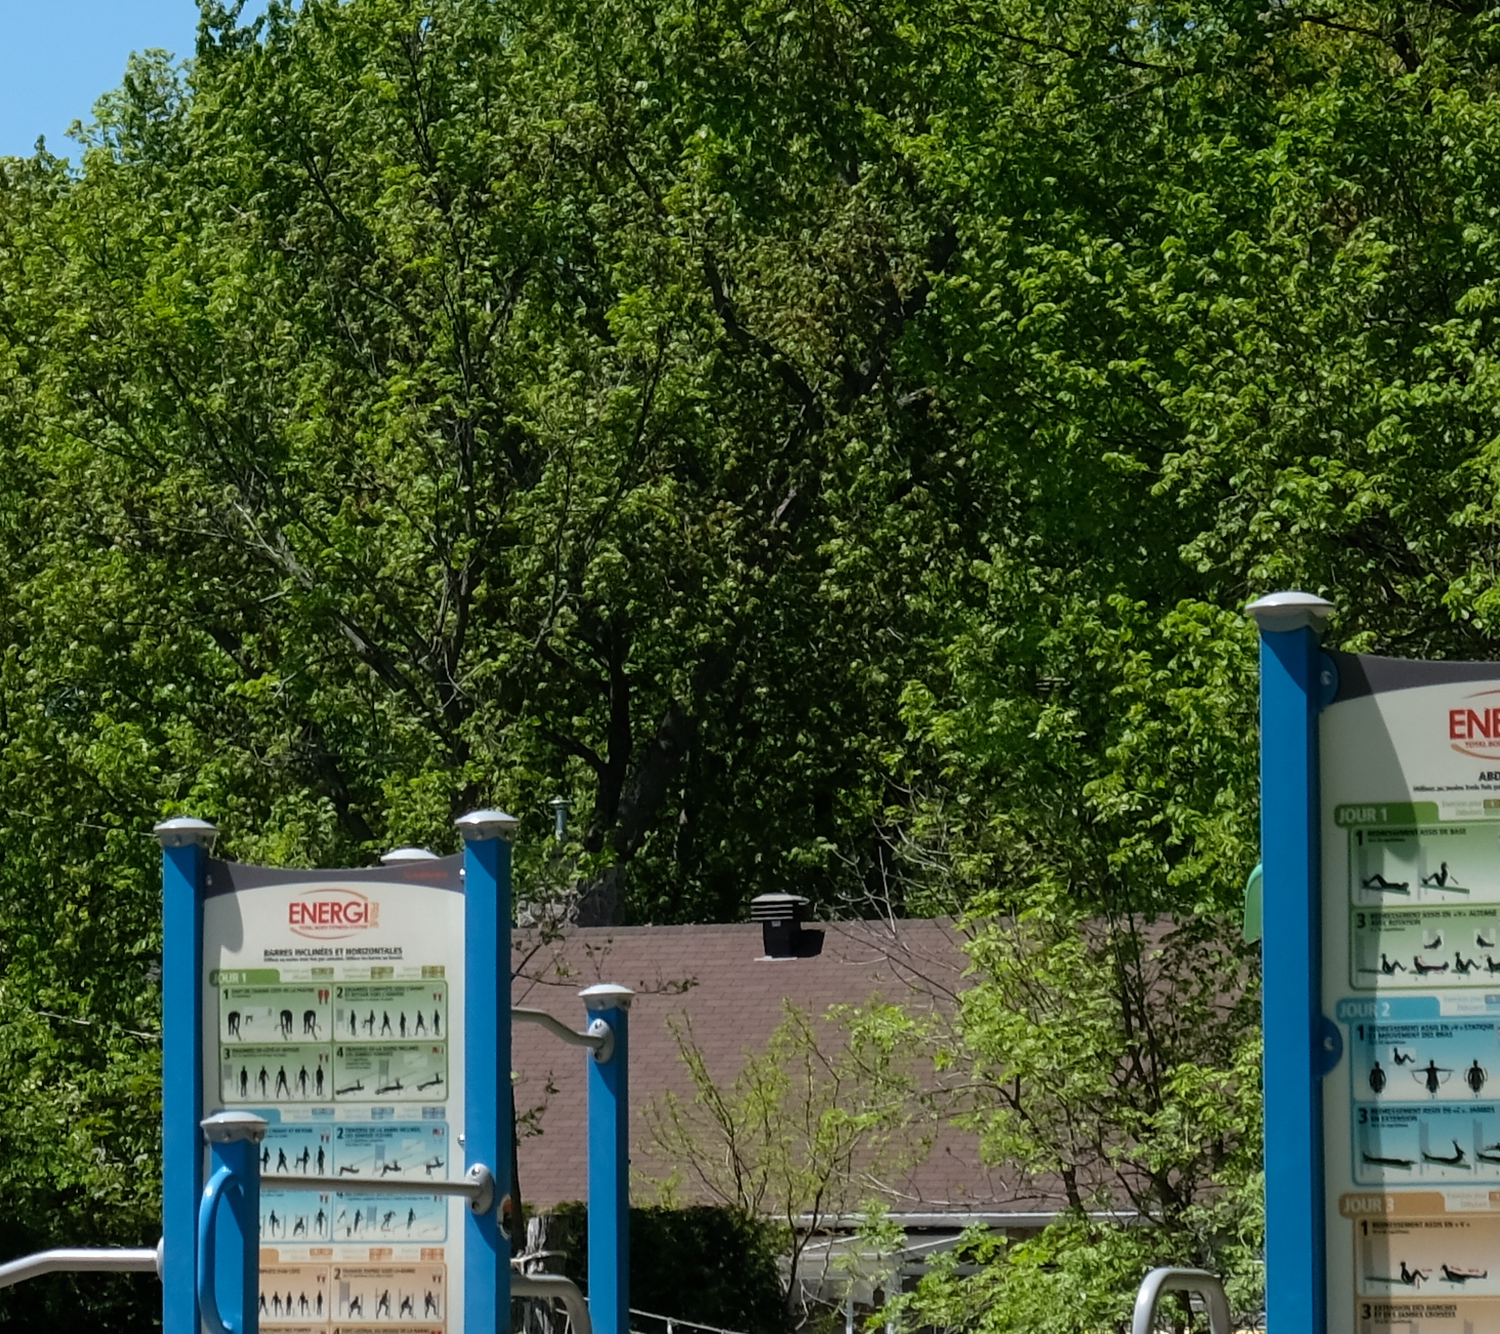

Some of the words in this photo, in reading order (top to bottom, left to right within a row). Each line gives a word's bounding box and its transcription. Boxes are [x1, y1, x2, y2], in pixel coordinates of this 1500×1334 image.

[1339, 808, 1377, 823] JOUR
[1381, 808, 1387, 821] 1
[1356, 830, 1363, 846] 1
[289, 902, 368, 924] ENERGI
[1357, 913, 1366, 929] 3
[264, 949, 292, 957] BARRES
[345, 947, 402, 955] HORIZONTALES
[242, 973, 246, 983] 1
[224, 990, 229, 999] 1
[337, 989, 343, 999] 2
[1340, 1003, 1377, 1017] JOUR
[1382, 1002, 1390, 1016] 2
[1357, 1025, 1364, 1041] 1
[224, 1050, 230, 1059] 3
[336, 1048, 343, 1058] 4
[1359, 1108, 1367, 1124] 3
[337, 1128, 344, 1139] 2
[1344, 1199, 1382, 1212] JOUR
[1386, 1198, 1394, 1212] 3
[1361, 1220, 1367, 1236] 1
[335, 1269, 340, 1280] 2
[1362, 1304, 1371, 1319] 3
